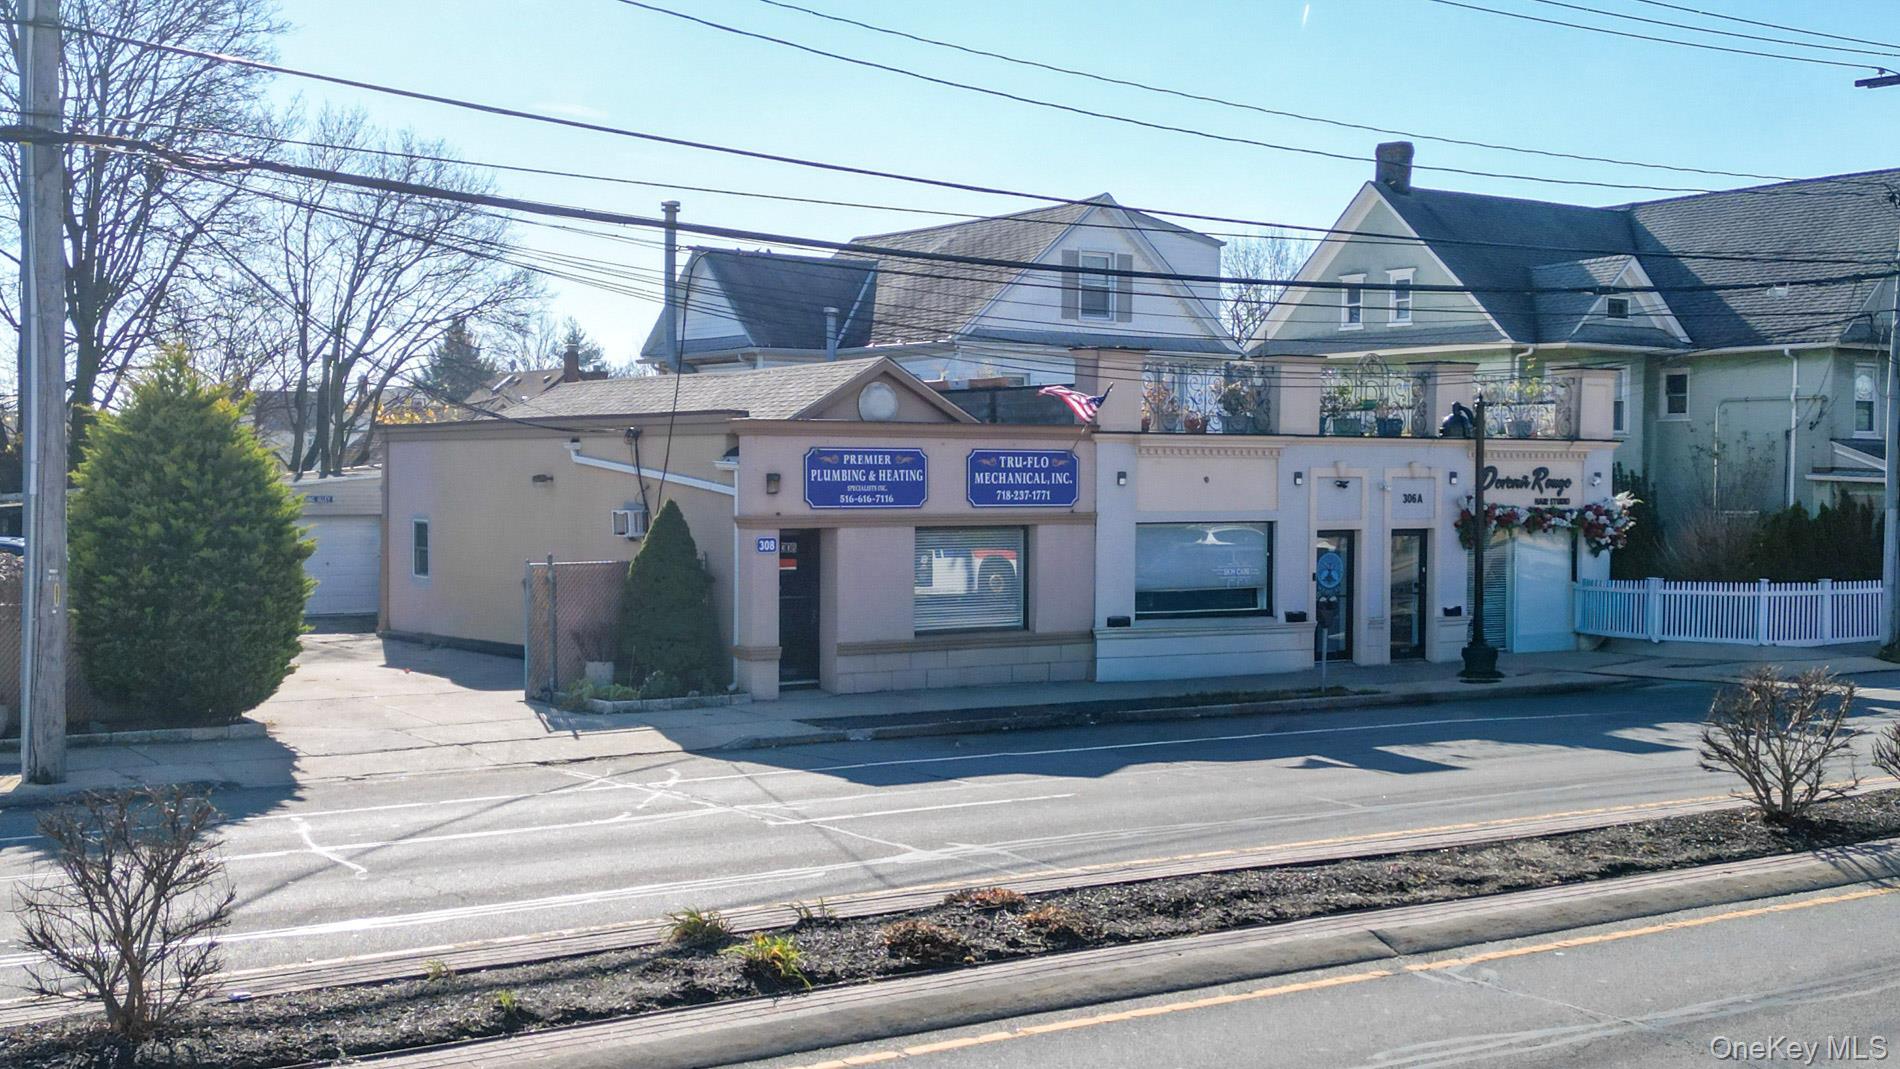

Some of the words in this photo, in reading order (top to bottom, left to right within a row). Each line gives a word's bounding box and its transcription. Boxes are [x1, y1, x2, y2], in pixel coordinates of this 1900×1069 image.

[843, 454, 892, 465] PREMIER
[999, 456, 1049, 468] TRU-FLO
[811, 469, 866, 482] PLUMBING
[868, 470, 876, 482] &
[878, 469, 923, 482] HEATING
[974, 472, 1050, 485] MECHANICAL,
[1051, 472, 1073, 485] INC.
[1532, 466, 1572, 497] Rouge
[840, 494, 894, 503] 516-616-7116
[996, 490, 1051, 500] 718-237-1771
[1402, 493, 1423, 504] 306A
[758, 539, 775, 551] 308
